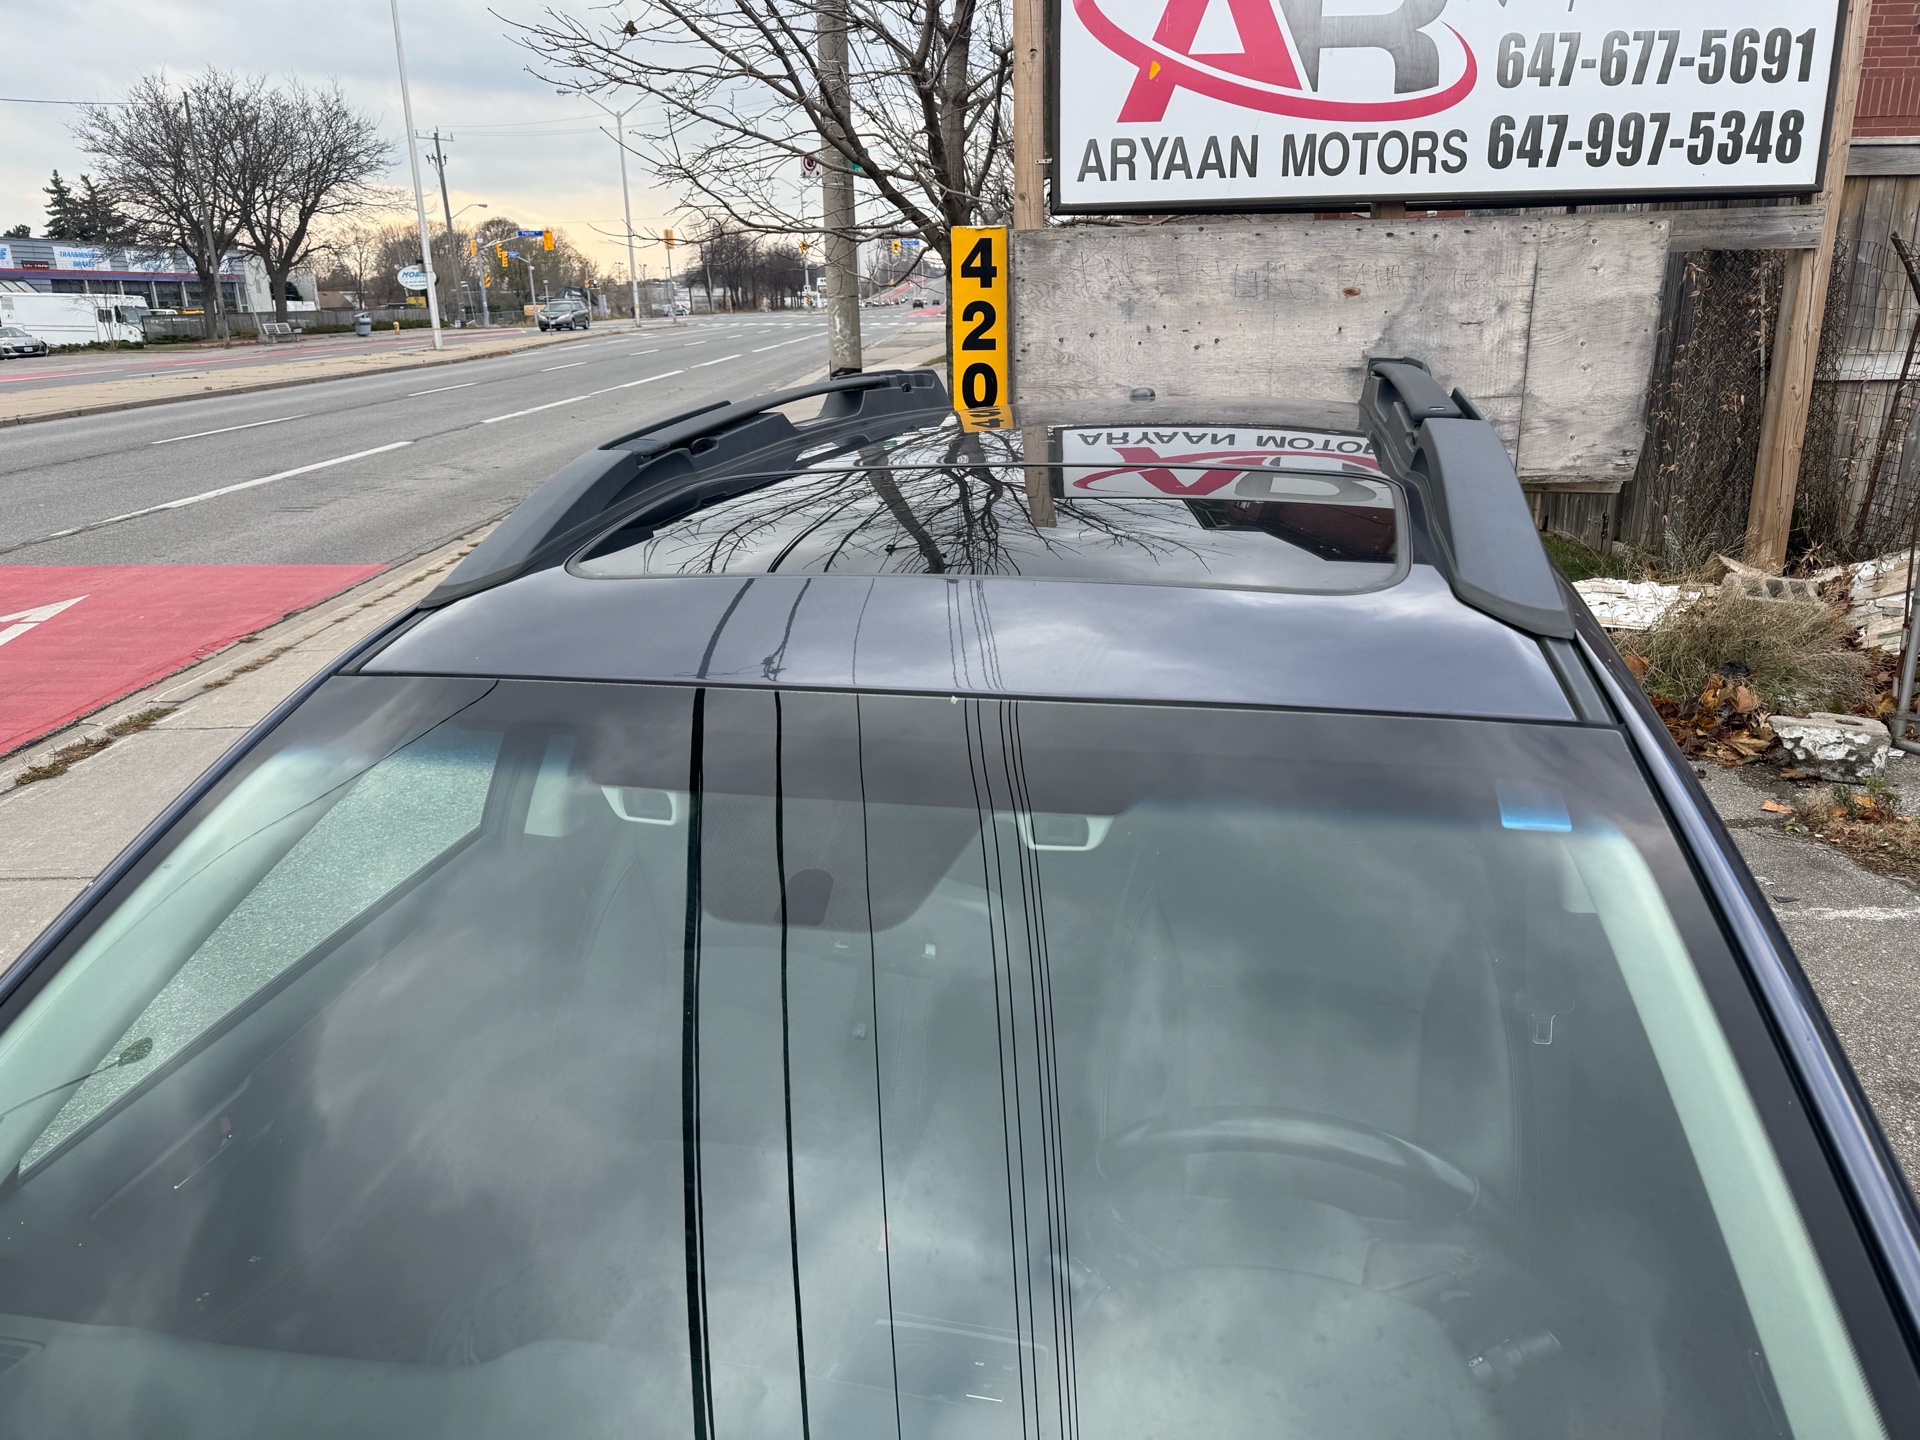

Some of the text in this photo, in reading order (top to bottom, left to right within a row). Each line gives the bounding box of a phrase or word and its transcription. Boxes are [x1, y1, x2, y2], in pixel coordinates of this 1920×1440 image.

[1496, 27, 1817, 89] 647-677-5691
[1076, 128, 1469, 182] ARYAAN MOTORS
[1487, 109, 1805, 169] 647-997-5348
[960, 237, 998, 408] 420
